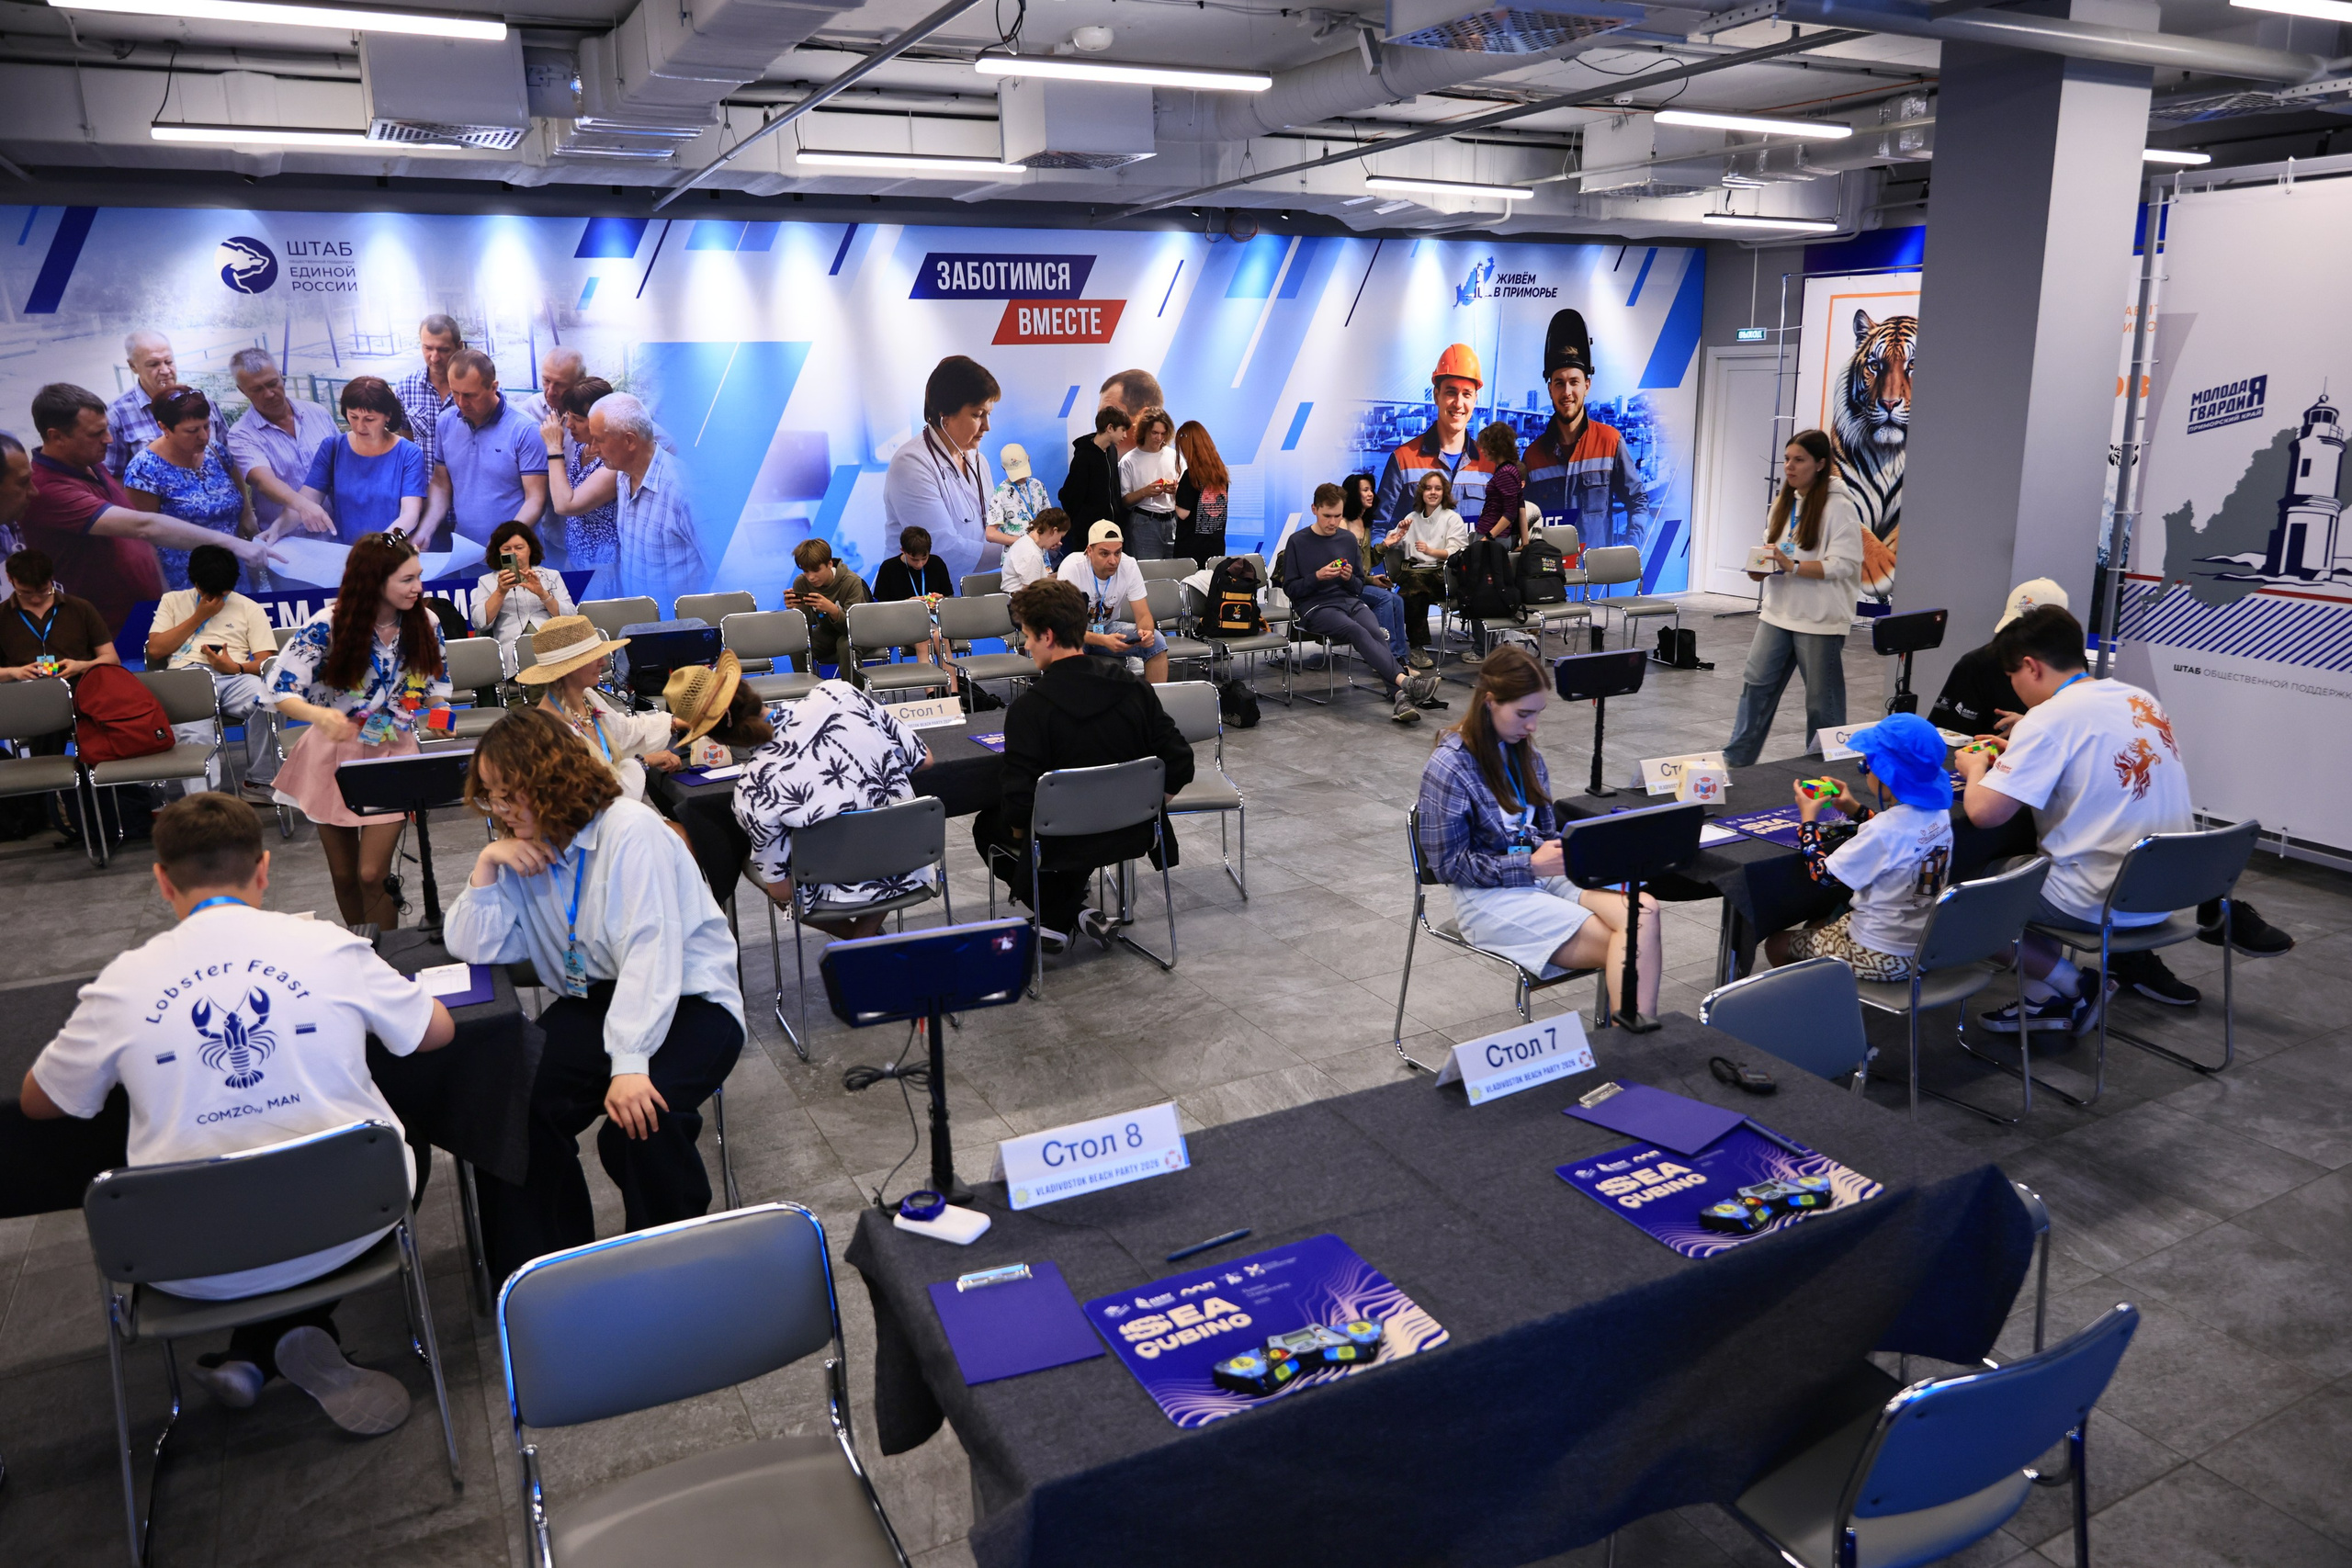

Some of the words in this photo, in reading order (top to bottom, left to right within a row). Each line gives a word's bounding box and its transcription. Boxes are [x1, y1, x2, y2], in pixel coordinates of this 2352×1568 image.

[287, 241, 353, 256] ШТАБ
[289, 265, 356, 278] ЕДИНОЙ
[936, 261, 1070, 290] ЗАБОТИМСЯ
[1496, 271, 1537, 285] ЖИВЁМ
[291, 281, 357, 292] РОССИИ
[1493, 287, 1501, 298] В
[1502, 287, 1558, 299] ПРИМОРЬЕ
[1018, 307, 1102, 335] ВМЕСТЕ
[1737, 331, 1763, 339] ВЫХОД
[2188, 412, 2241, 433] ПРИМОРСКИЙ
[2241, 409, 2263, 420] КРАЙ
[2173, 663, 2201, 675] ШТАБ
[2203, 668, 2289, 690] ОБЩЕСТВЕННОЙ
[899, 707, 933, 719] Стол
[937, 704, 944, 715] 1
[145, 962, 233, 1024] Lobster
[247, 959, 311, 999] Feast
[1486, 1038, 1543, 1067] Стол
[1544, 1027, 1556, 1050] 7
[1485, 1076, 1523, 1093] VLADIVOSTOK
[1524, 1067, 1543, 1082] BEACH
[1543, 1063, 1561, 1076] PARTY
[267, 1093, 300, 1110] MAN
[1043, 1134, 1117, 1167] Стол
[1125, 1122, 1143, 1147] 8
[1035, 1177, 1087, 1196] VLADIVOSTOK
[1089, 1170, 1114, 1184] BEACH
[1114, 1164, 1139, 1177] PARTY
[1140, 1158, 1159, 1171] 2026
[1595, 1161, 1692, 1197] SEA
[1617, 1173, 1708, 1209] CUBING
[1118, 1296, 1241, 1342] SEA
[1134, 1313, 1253, 1359] CUBING
